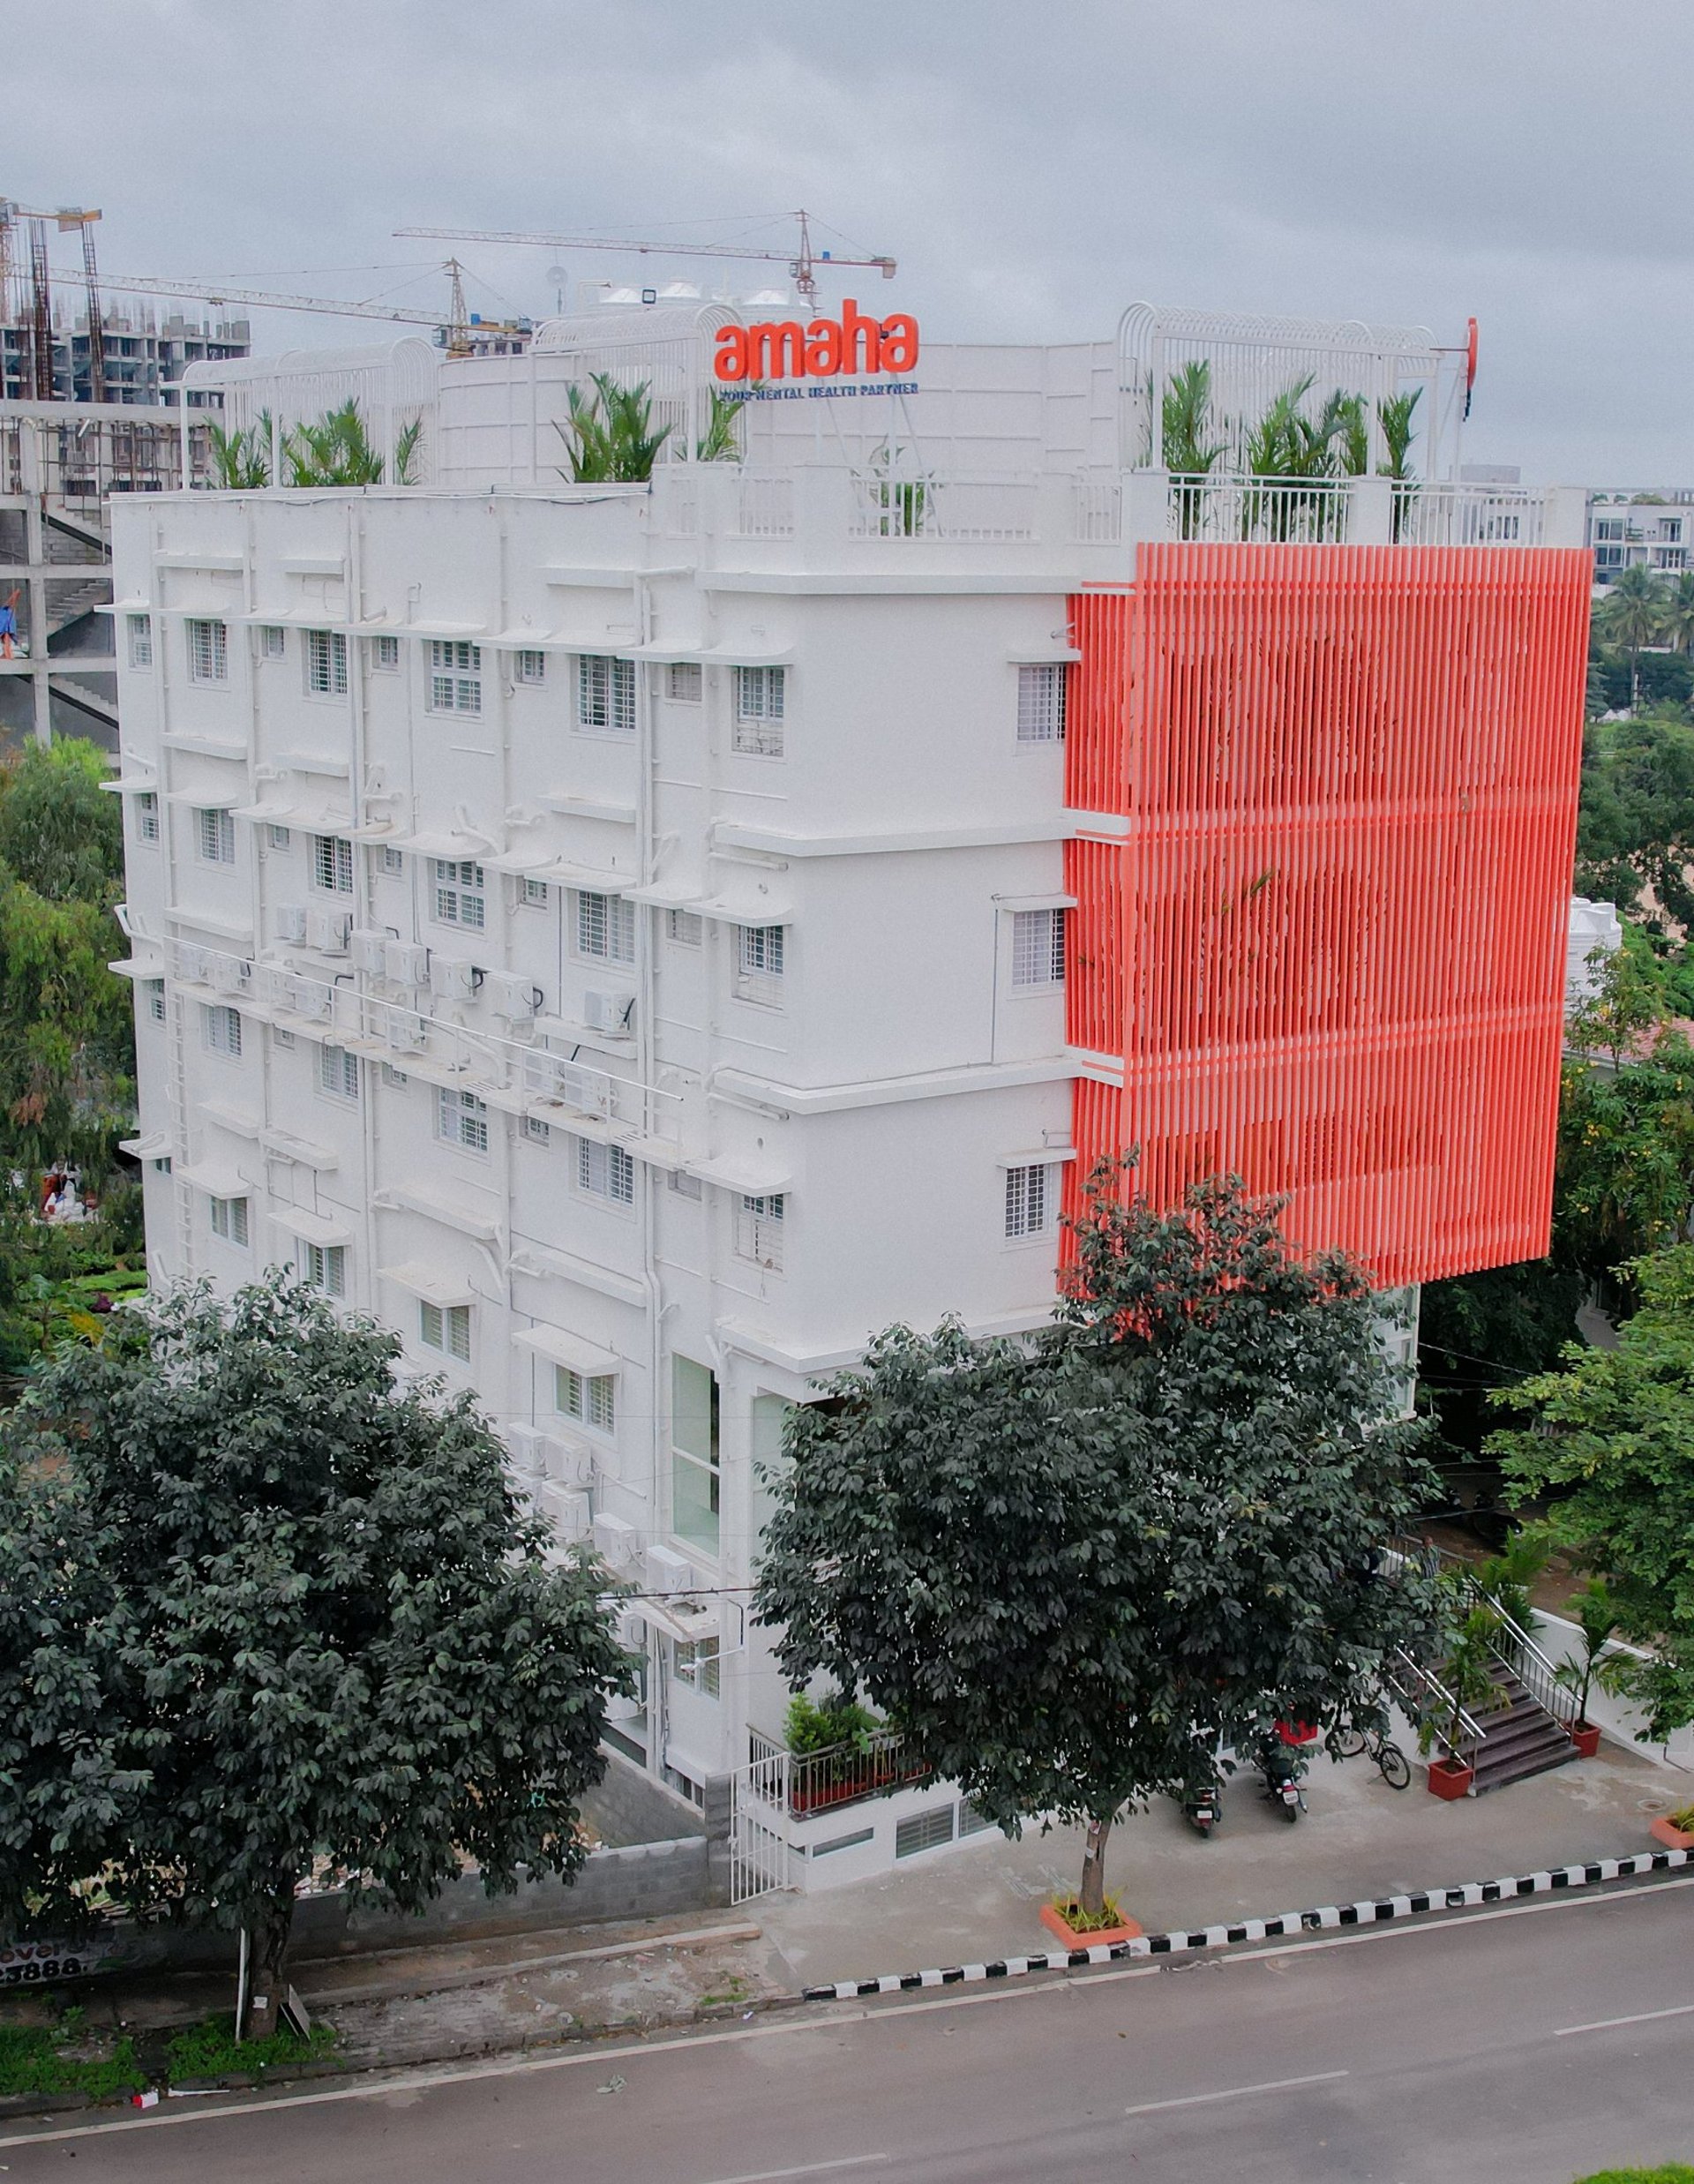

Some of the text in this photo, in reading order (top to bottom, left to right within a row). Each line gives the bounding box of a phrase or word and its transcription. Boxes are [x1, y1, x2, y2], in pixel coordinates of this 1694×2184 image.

[714, 297, 919, 382] amaha
[756, 387, 805, 401] MENTAL
[808, 385, 857, 397] HEALTH
[860, 382, 918, 396] PARTNER
